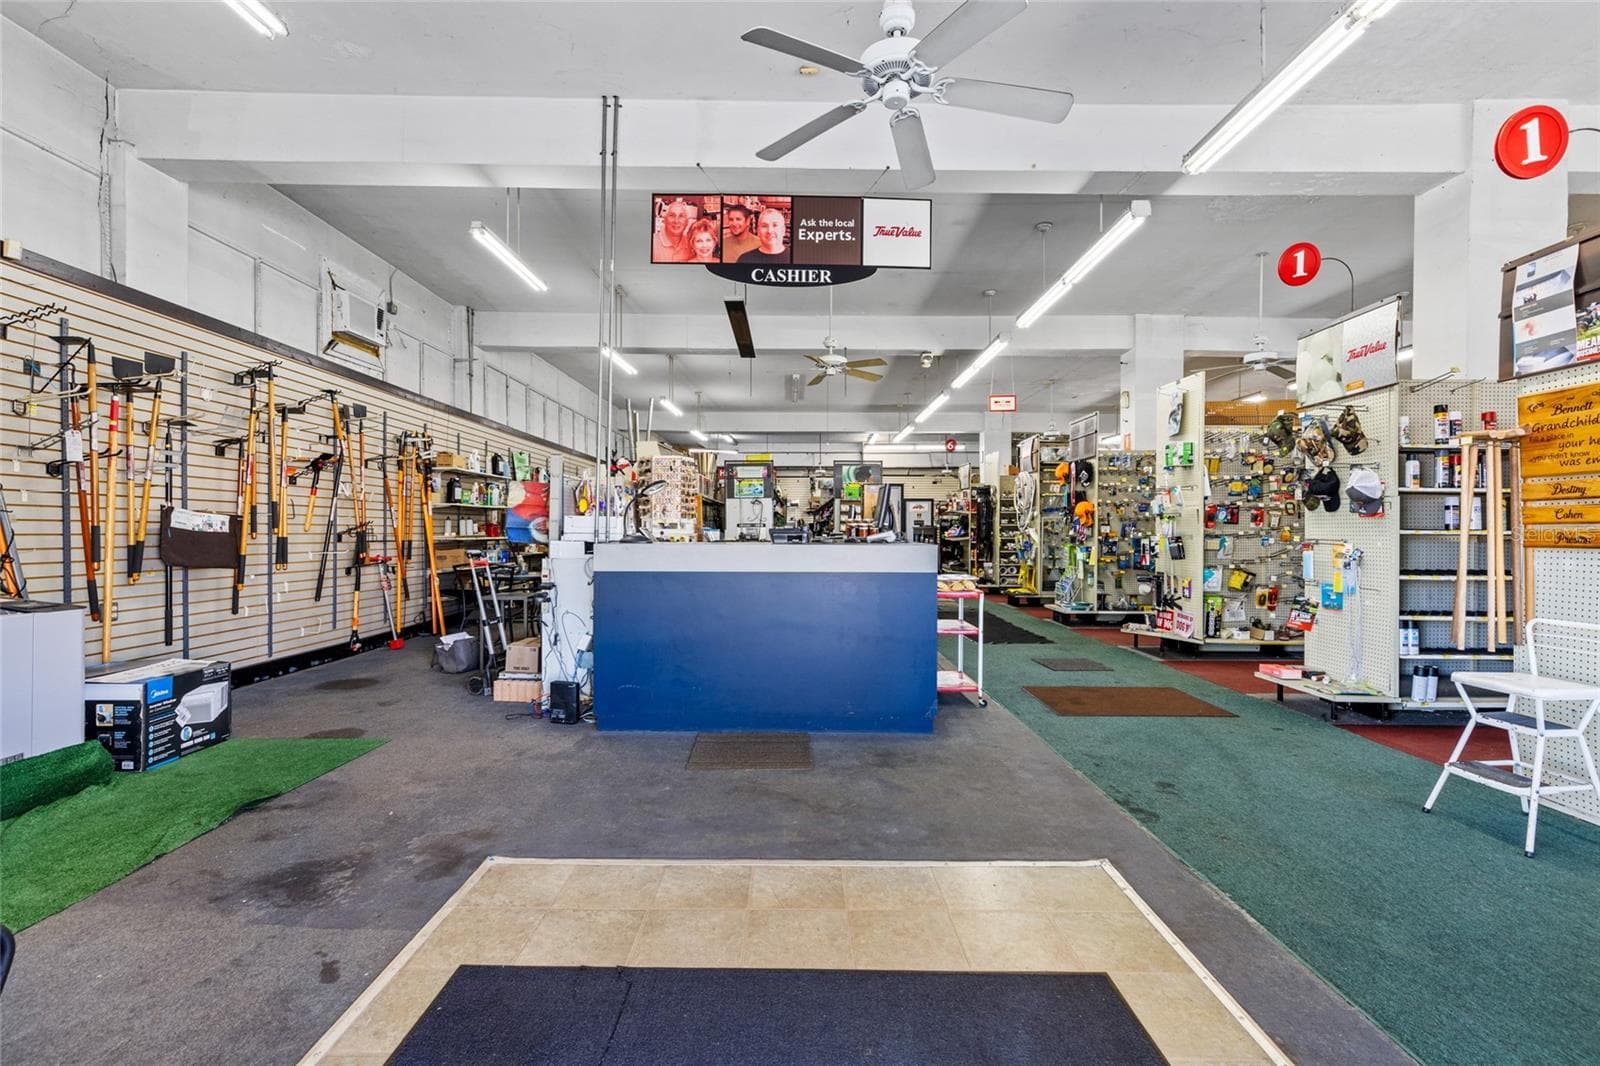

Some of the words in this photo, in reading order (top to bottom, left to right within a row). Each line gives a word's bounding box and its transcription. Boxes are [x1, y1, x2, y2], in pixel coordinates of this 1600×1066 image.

[1519, 116, 1549, 166] 1
[800, 218, 817, 227] Ask
[818, 218, 834, 227] the
[835, 218, 855, 227] local
[798, 228, 856, 243] Experts.
[1293, 250, 1308, 278] 1
[750, 268, 833, 284] CASHIER
[1551, 401, 1593, 416] Bennett
[1531, 413, 1600, 433] Grandchild
[1558, 440, 1584, 452] your
[1559, 458, 1581, 467] was
[1551, 483, 1587, 497] Destiny
[1554, 508, 1584, 520] Cohen
